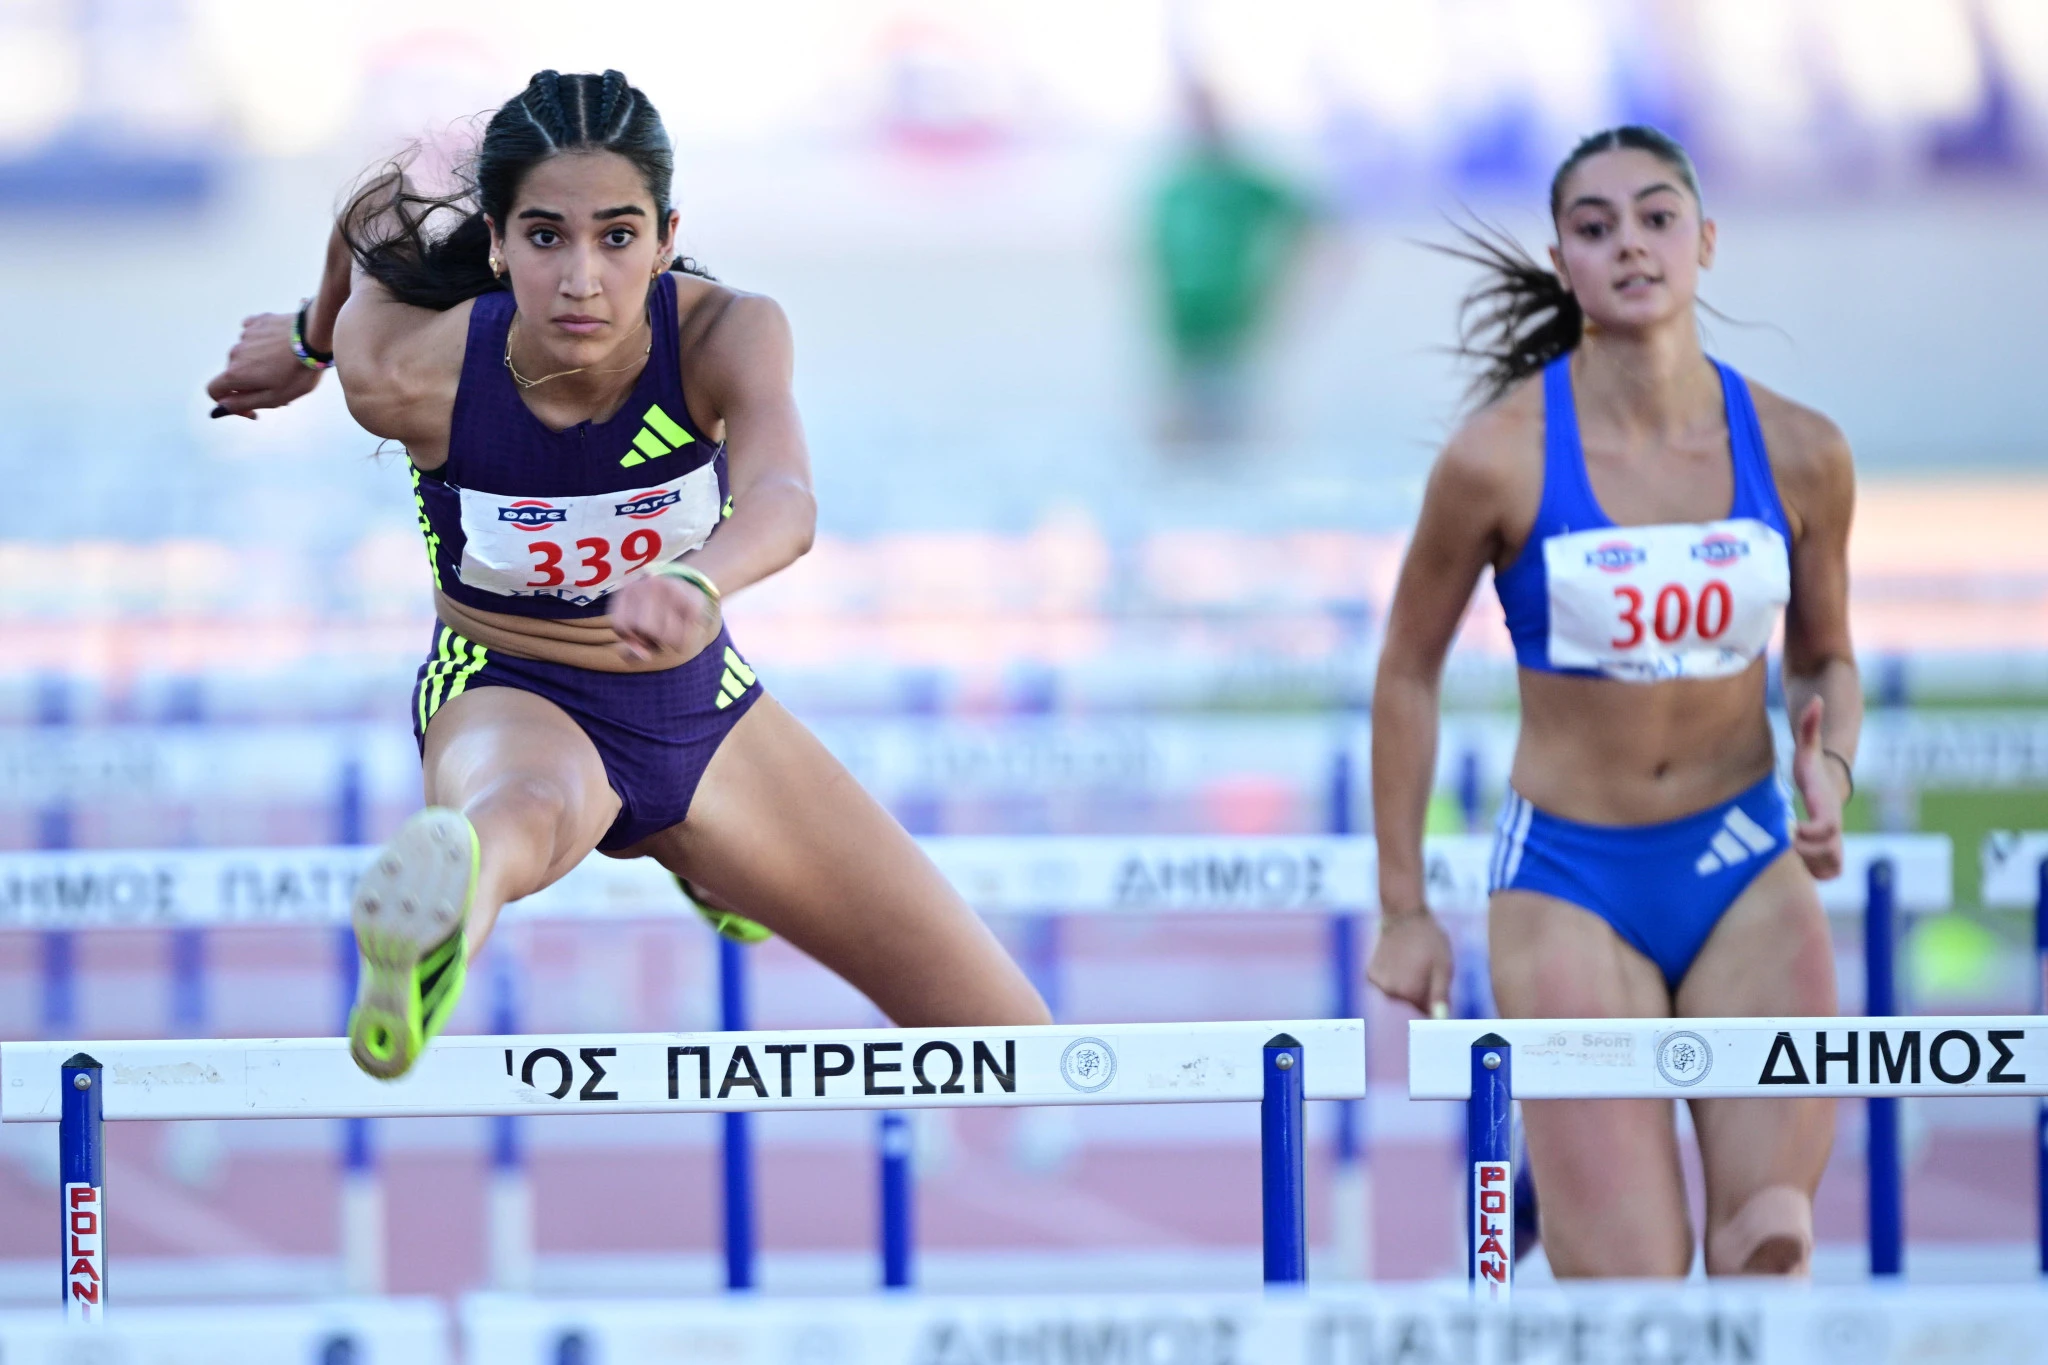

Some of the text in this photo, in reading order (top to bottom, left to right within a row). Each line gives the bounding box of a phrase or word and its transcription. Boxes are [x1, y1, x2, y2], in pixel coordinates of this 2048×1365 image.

[526, 528, 663, 588] 339
[1611, 579, 1734, 649] 300
[667, 1039, 1016, 1100] ΠΑΤΡΕΩΝ
[1758, 1030, 2026, 1085] ΔΗΜΟΣ
